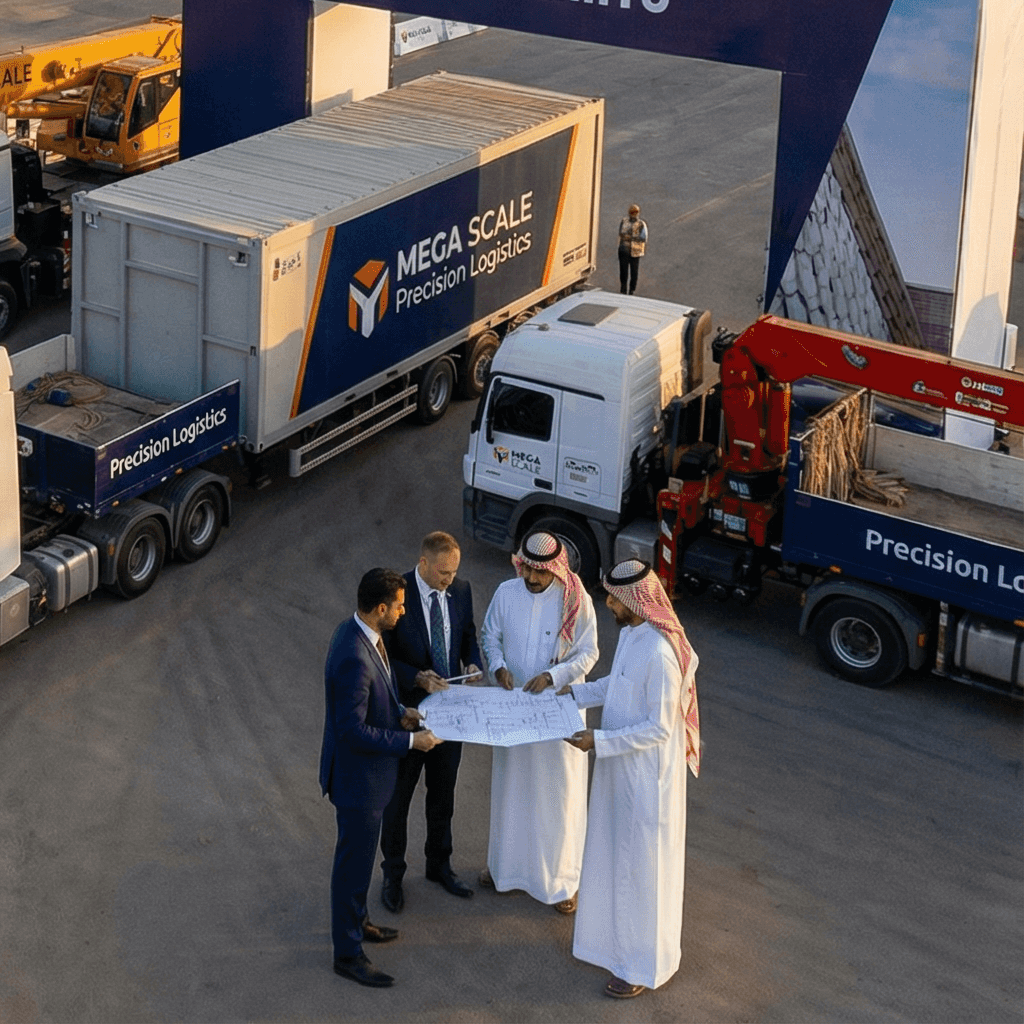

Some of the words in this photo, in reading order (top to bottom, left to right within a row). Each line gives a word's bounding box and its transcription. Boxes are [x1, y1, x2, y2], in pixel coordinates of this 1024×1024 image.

[396, 225, 463, 282] MEGA
[467, 190, 533, 247] SCALE
[396, 264, 466, 313] Precision
[470, 232, 532, 277] Logistics
[110, 436, 170, 479] Precision
[172, 407, 227, 447] Logistics
[865, 528, 989, 583] Precision
